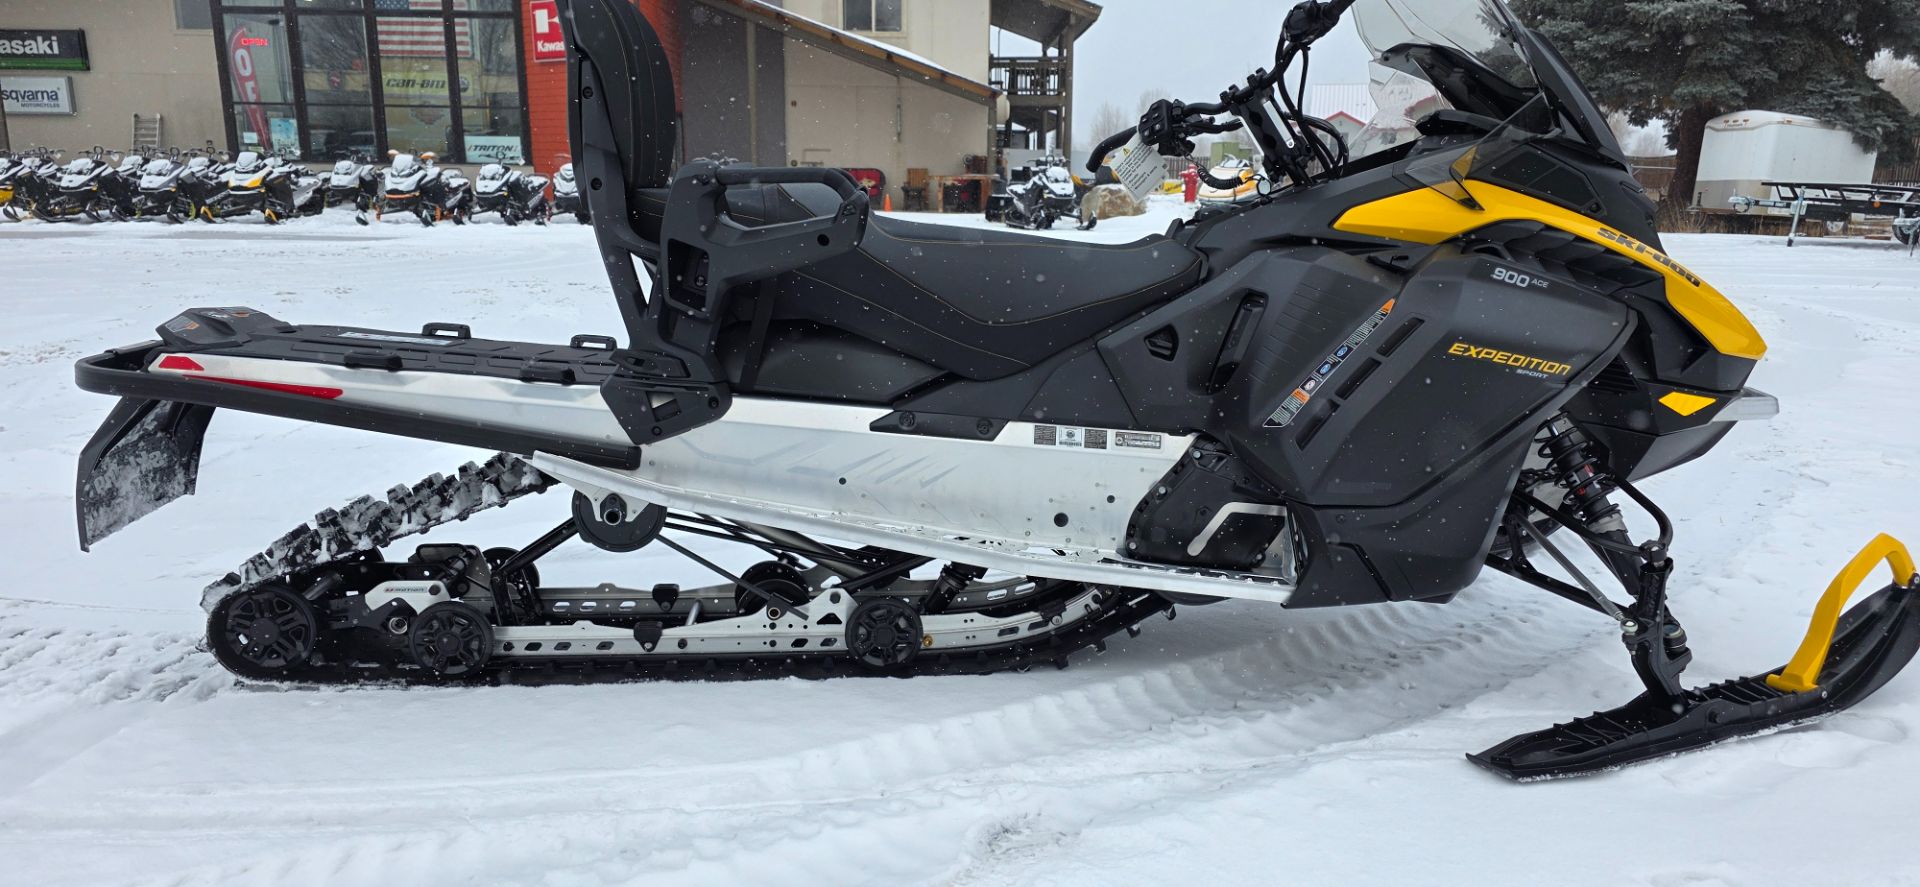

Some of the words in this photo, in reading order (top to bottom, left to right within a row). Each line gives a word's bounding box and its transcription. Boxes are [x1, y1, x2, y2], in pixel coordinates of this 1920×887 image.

[472, 144, 514, 152] TRITON
[1491, 267, 1530, 288] 900
[1531, 278, 1549, 288] ACE
[1448, 342, 1571, 376] EXPEDITION
[1515, 368, 1549, 379] SPORT
